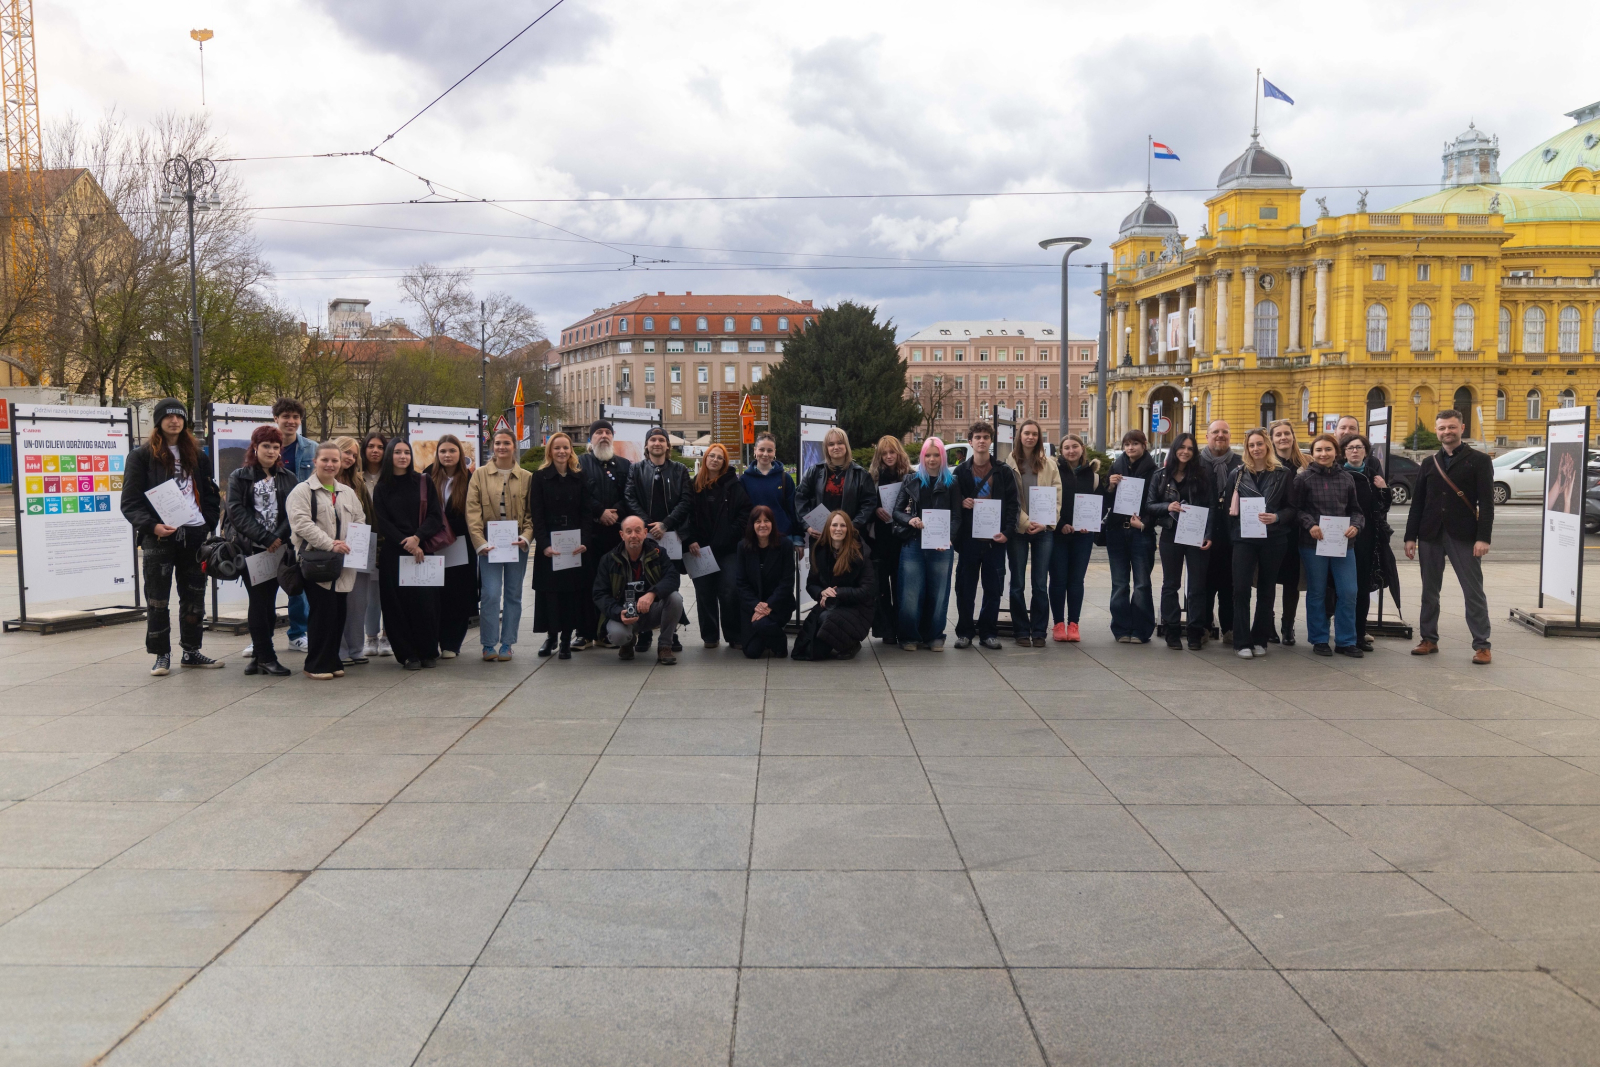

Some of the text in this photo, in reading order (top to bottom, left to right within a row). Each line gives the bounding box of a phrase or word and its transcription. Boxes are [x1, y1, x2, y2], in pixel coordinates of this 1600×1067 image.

[24, 439, 117, 449] UN-OVI CILJEVI ODRŽIVOG RAZVOJA
